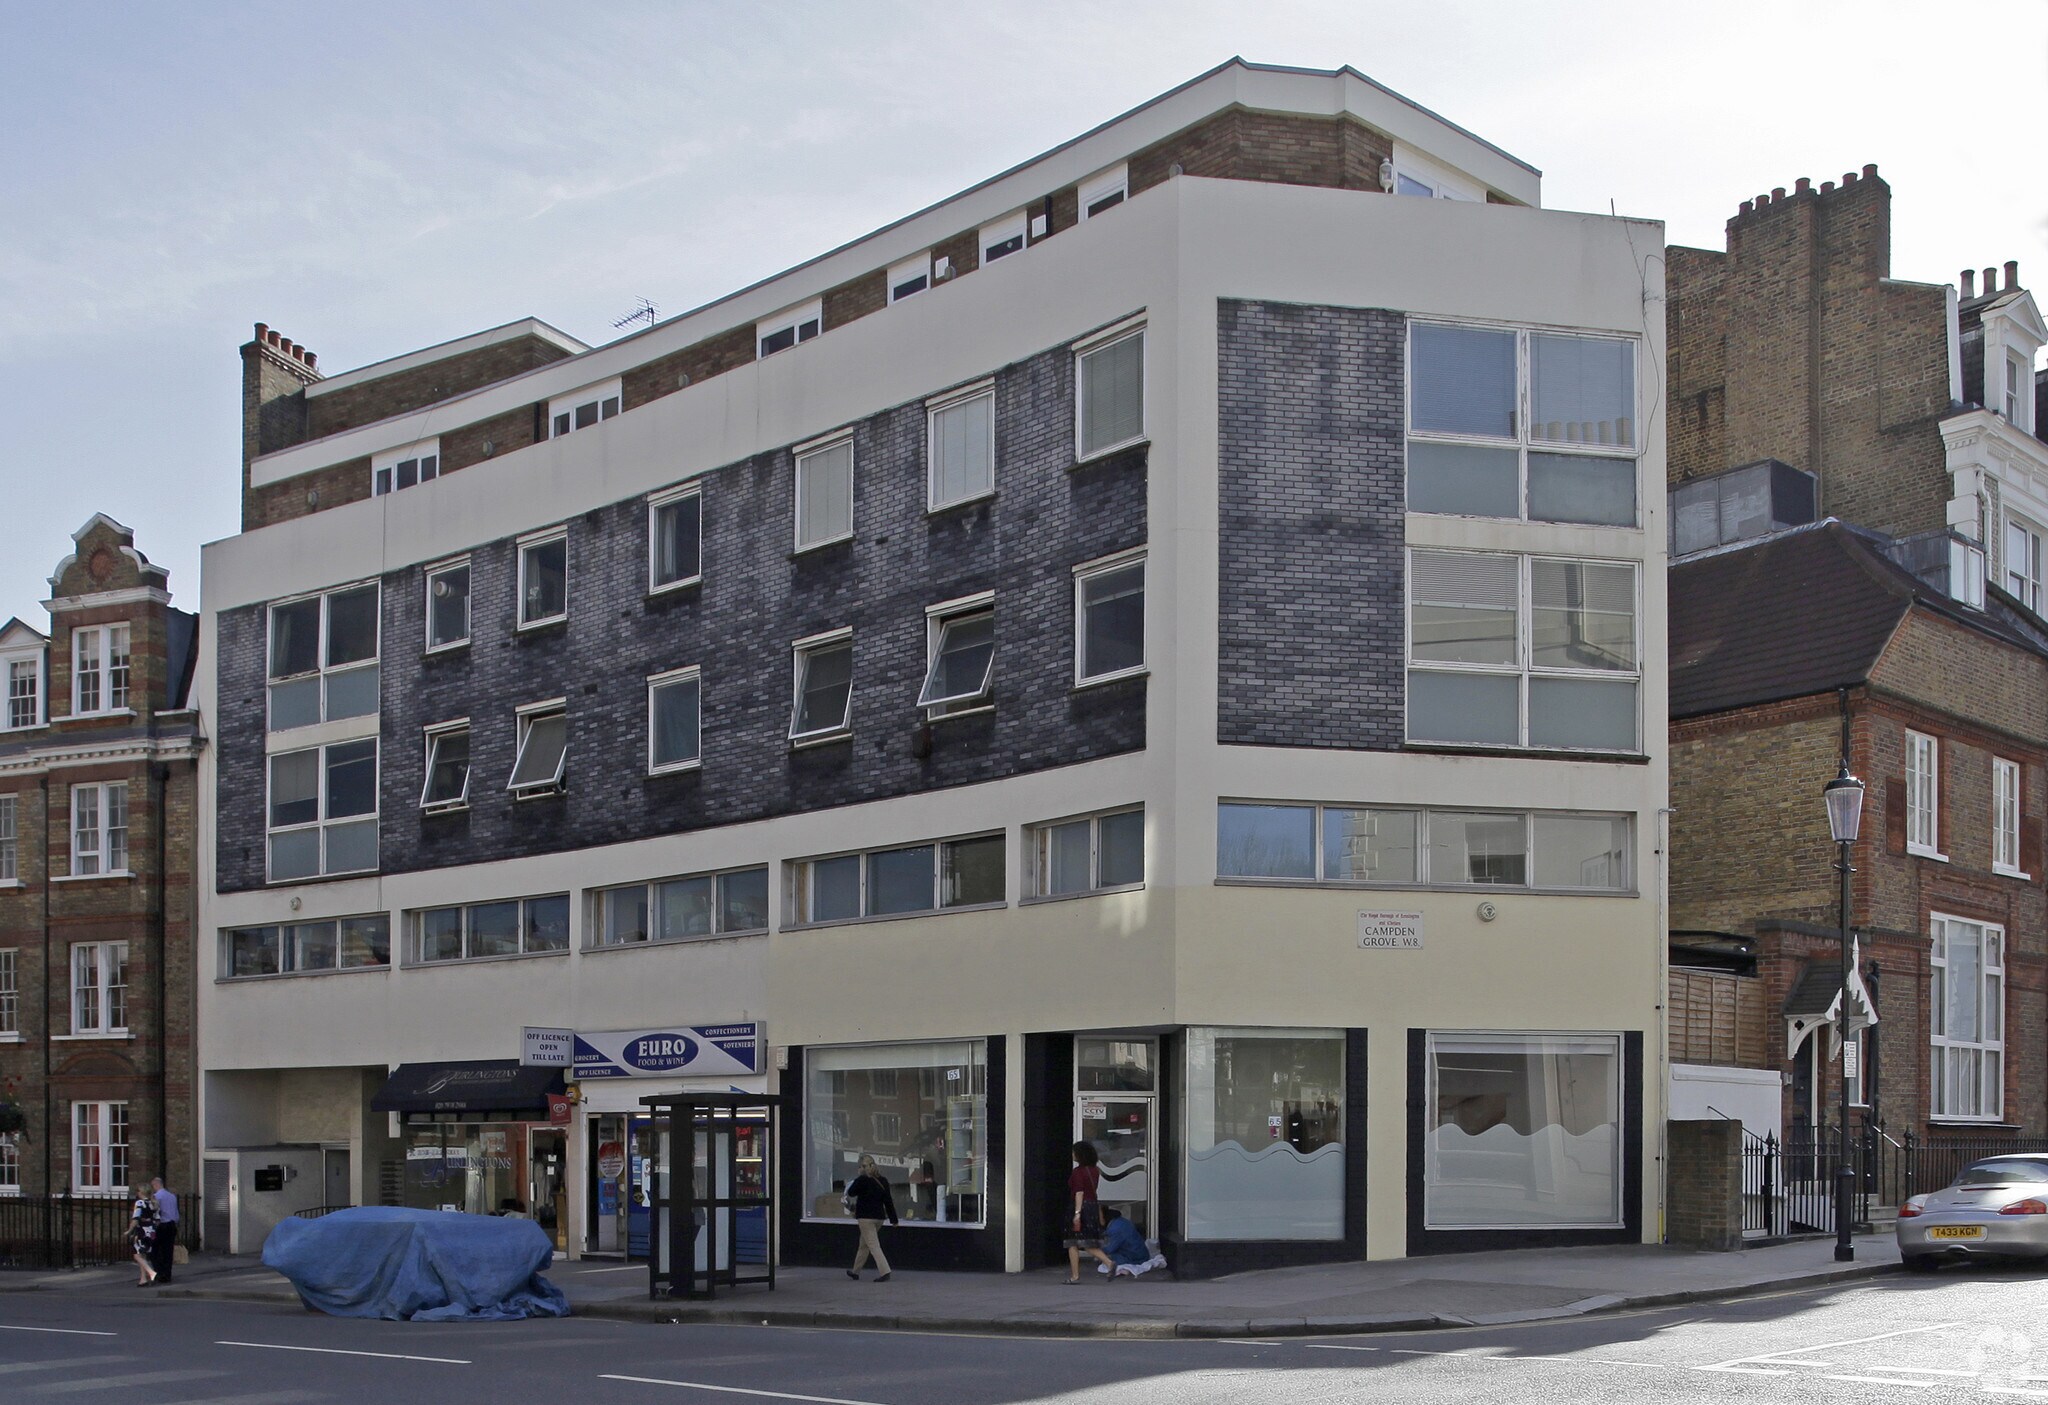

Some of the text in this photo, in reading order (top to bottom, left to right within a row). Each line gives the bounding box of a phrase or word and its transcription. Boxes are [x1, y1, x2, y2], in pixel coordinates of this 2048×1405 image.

[1365, 927, 1415, 935] CAMPDEN
[705, 1026, 752, 1036] CONFECTIONERY
[541, 1033, 570, 1042] LICENCE
[539, 1043, 558, 1051] OPEN
[637, 1038, 687, 1057] EURO
[531, 1053, 565, 1061] TILL LATE
[637, 1059, 657, 1067] FOOD
[665, 1057, 686, 1065] WINE
[1936, 1227, 1977, 1236] T433 KGN
